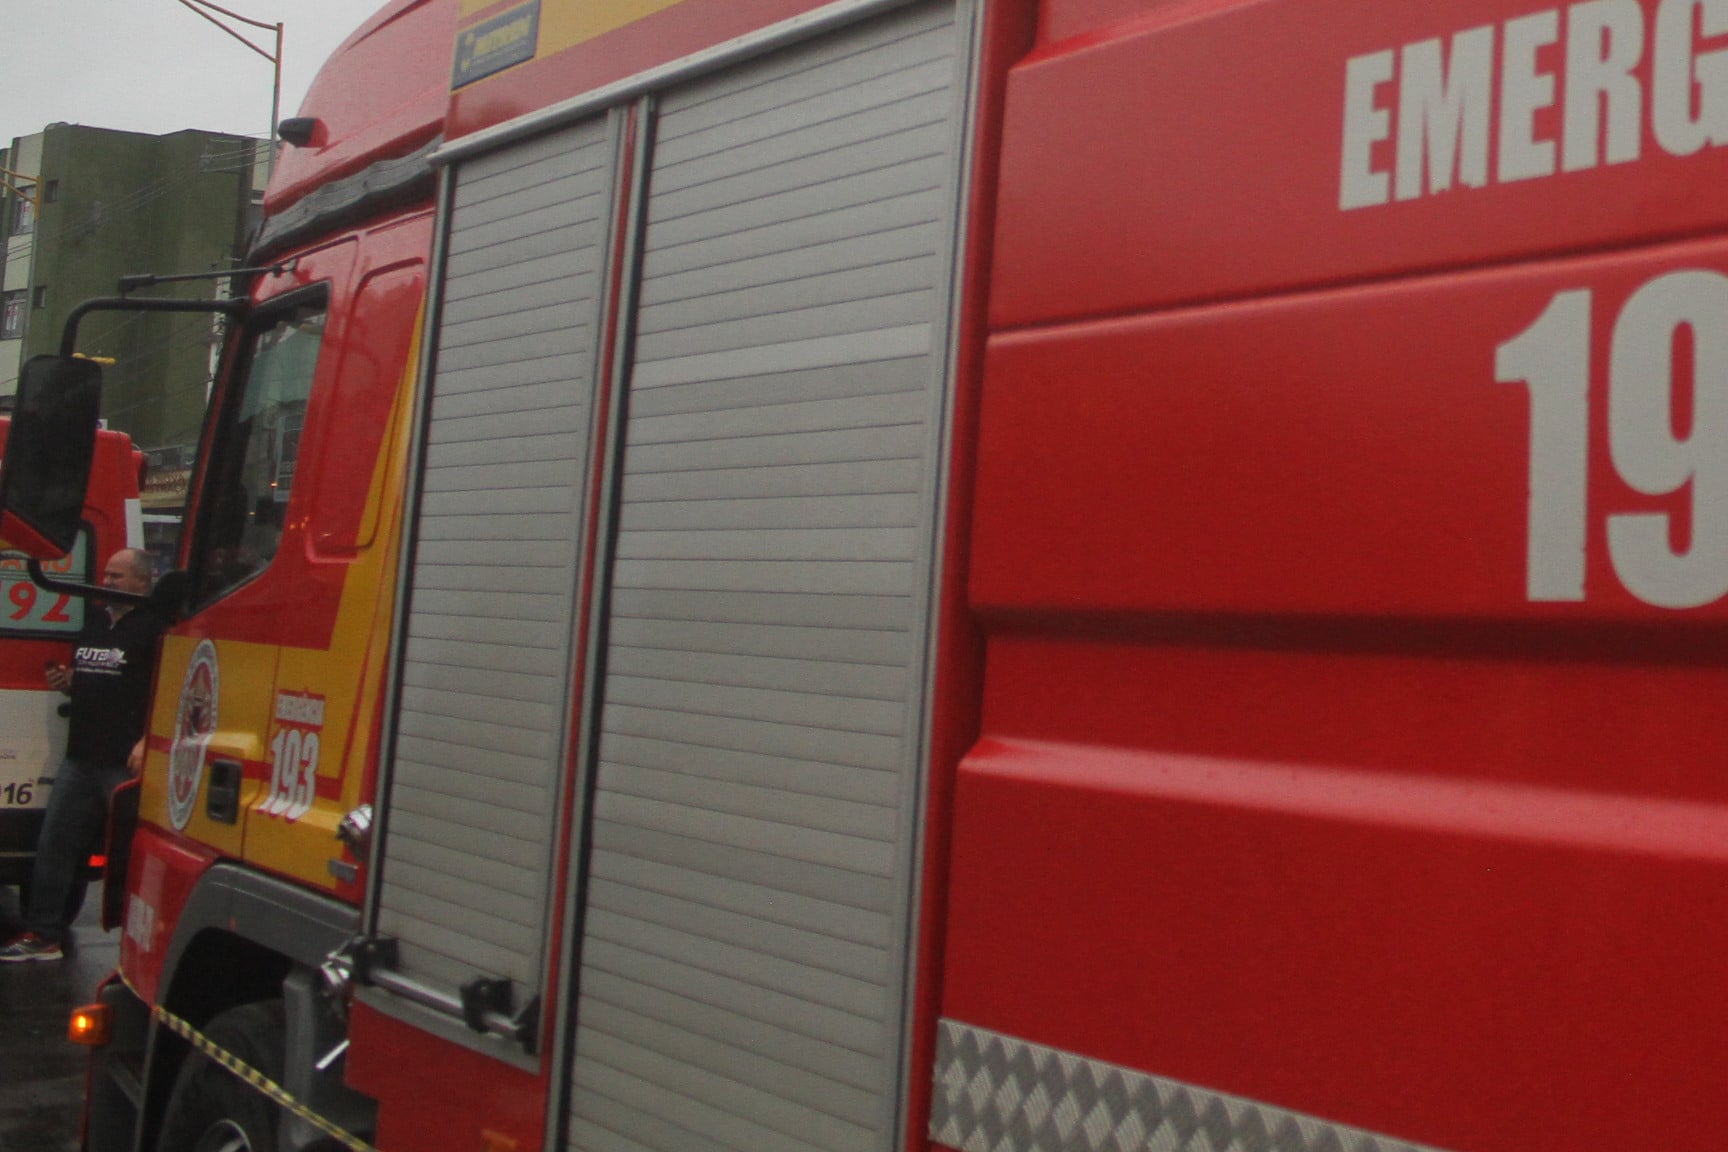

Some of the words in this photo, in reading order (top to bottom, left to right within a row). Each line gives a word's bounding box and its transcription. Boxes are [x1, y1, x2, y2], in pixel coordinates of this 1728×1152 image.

[0, 580, 72, 623] 92
[0, 782, 33, 805] 16
[259, 728, 320, 820] 193
